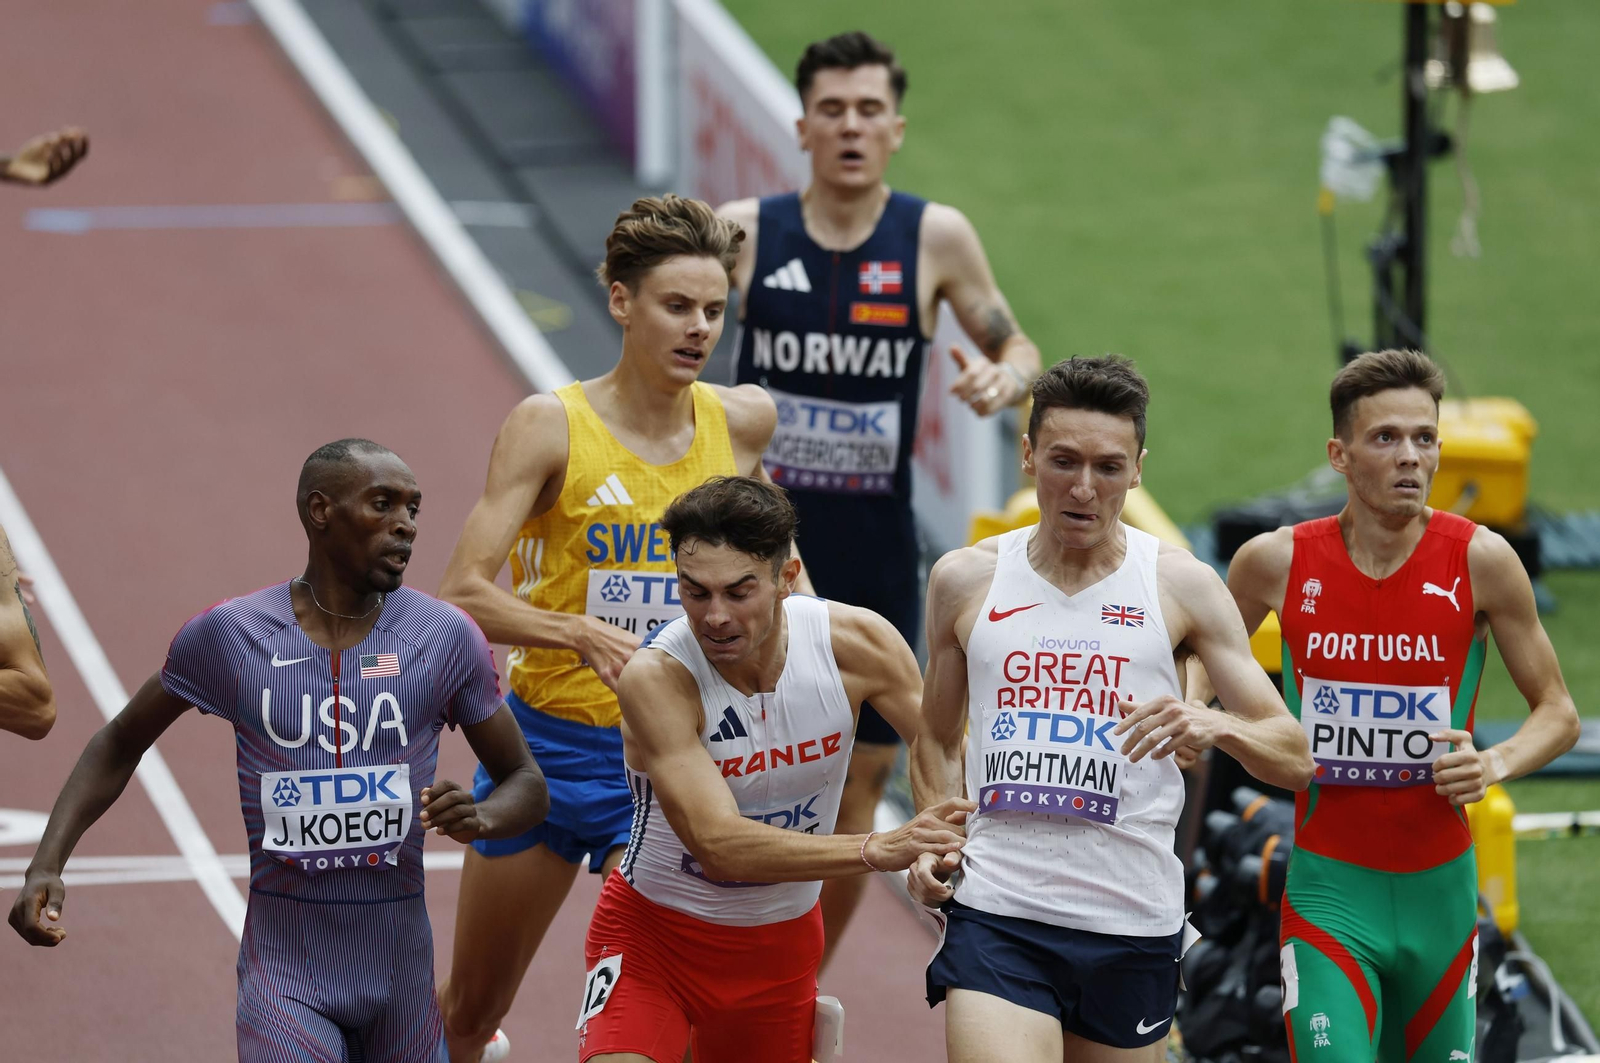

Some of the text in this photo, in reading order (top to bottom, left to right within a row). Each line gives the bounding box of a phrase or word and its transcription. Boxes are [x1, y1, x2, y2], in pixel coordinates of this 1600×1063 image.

[753, 326, 915, 378] NORWAY
[800, 402, 886, 436] TDK
[1301, 604, 1316, 615] FPA
[1031, 635, 1101, 651] Novuna
[1306, 632, 1445, 662] PORTUGAL
[1003, 650, 1130, 688] GREAT
[262, 687, 408, 754] USA
[1340, 687, 1439, 722] TDK
[1017, 711, 1119, 752] TDK
[1312, 723, 1434, 760] PINTO
[299, 770, 400, 806] TDK
[985, 750, 1118, 794] WIGHTMAN
[1088, 800, 1111, 816] 25
[584, 966, 615, 1016] 12
[1313, 1038, 1331, 1048] FPA
